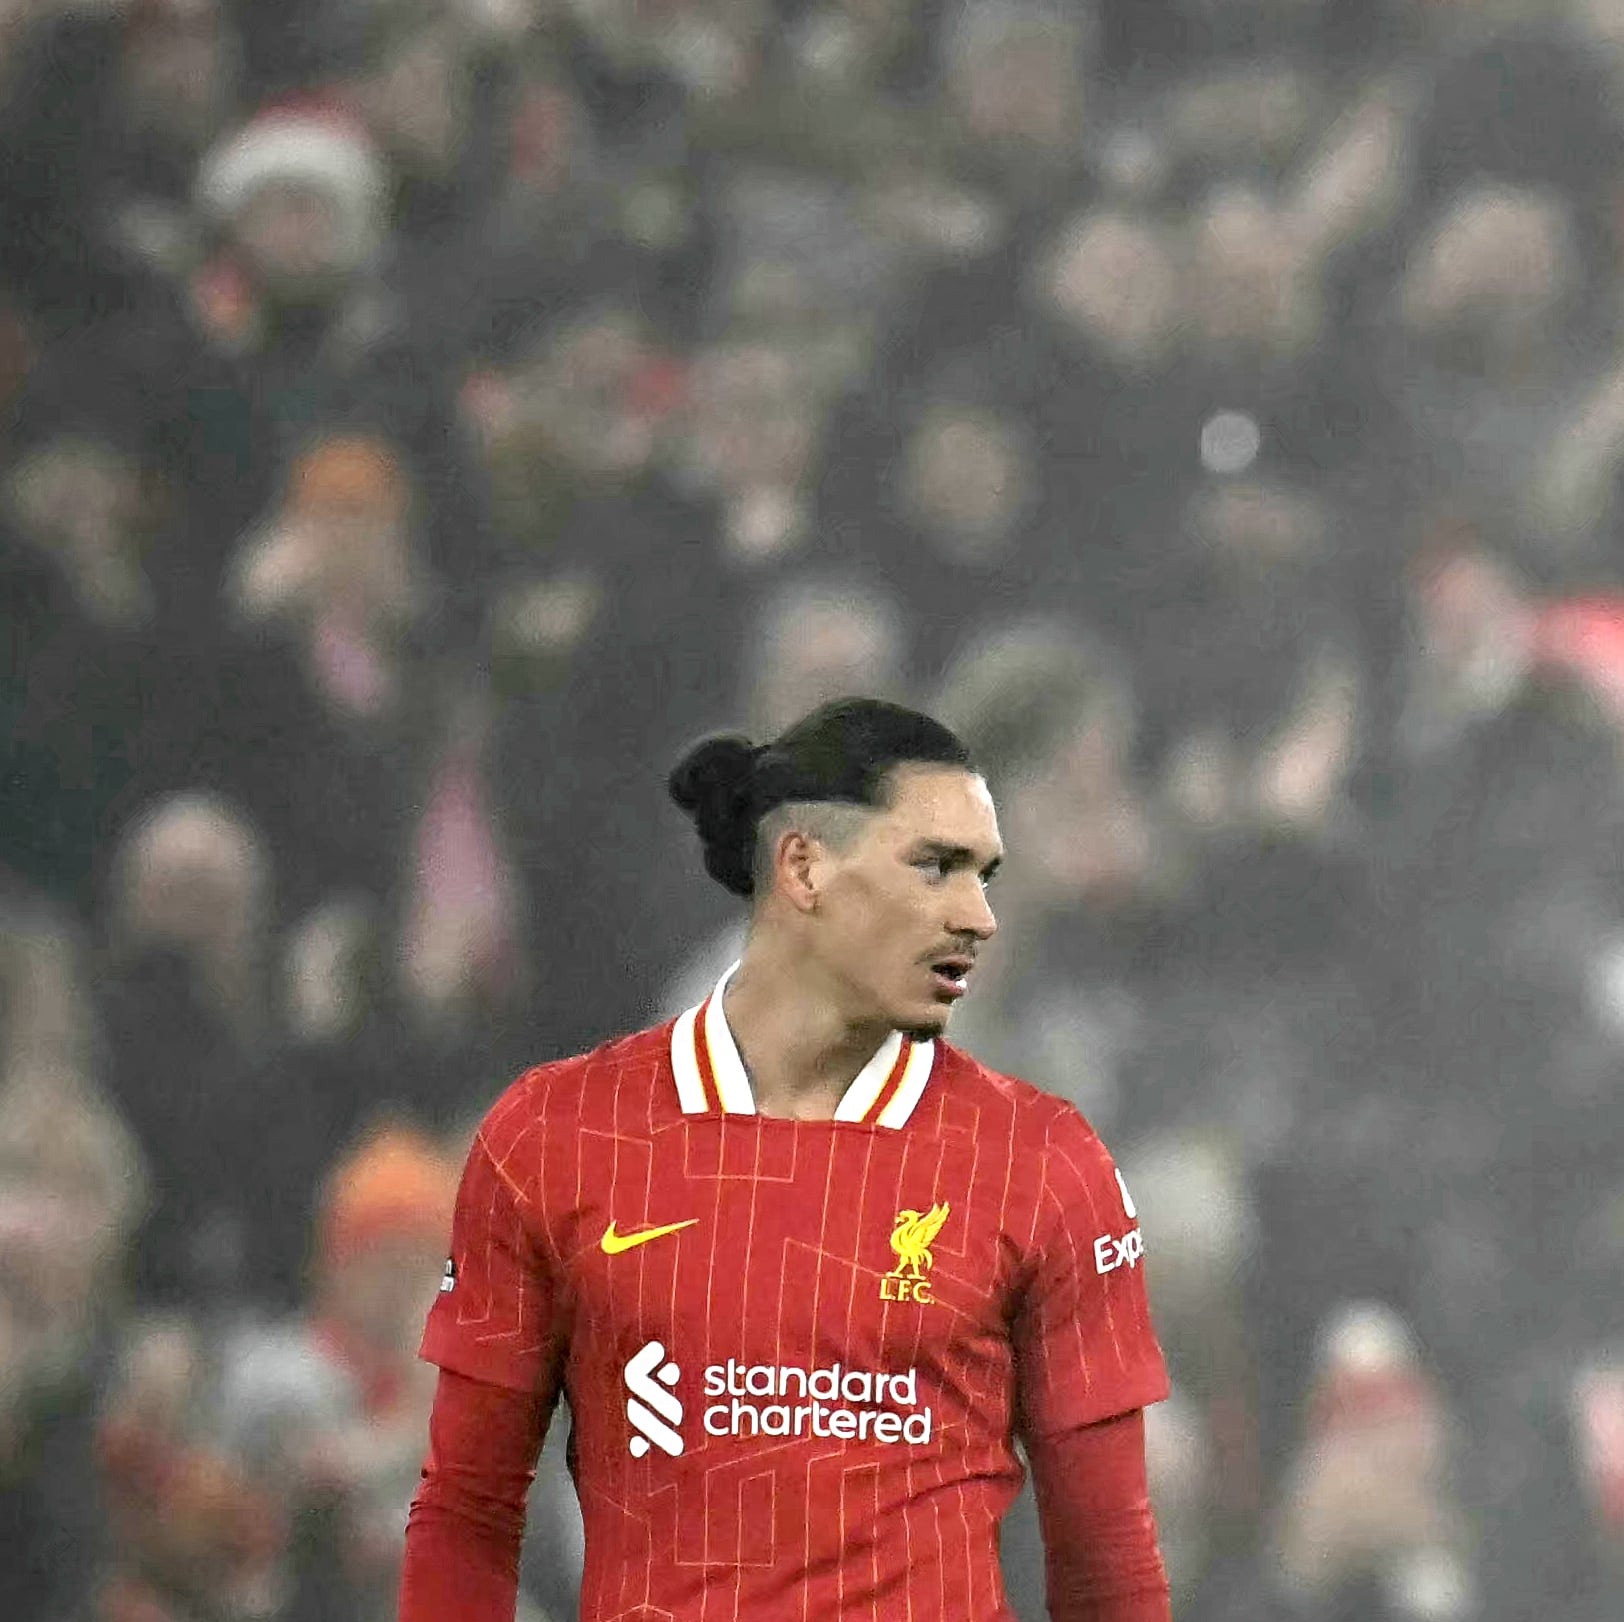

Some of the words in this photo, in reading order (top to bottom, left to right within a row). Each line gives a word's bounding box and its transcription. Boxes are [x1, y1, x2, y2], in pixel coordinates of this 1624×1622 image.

[1094, 1228, 1144, 1275] Exp
[703, 1358, 917, 1406] standard
[703, 1398, 932, 1445] chartered
